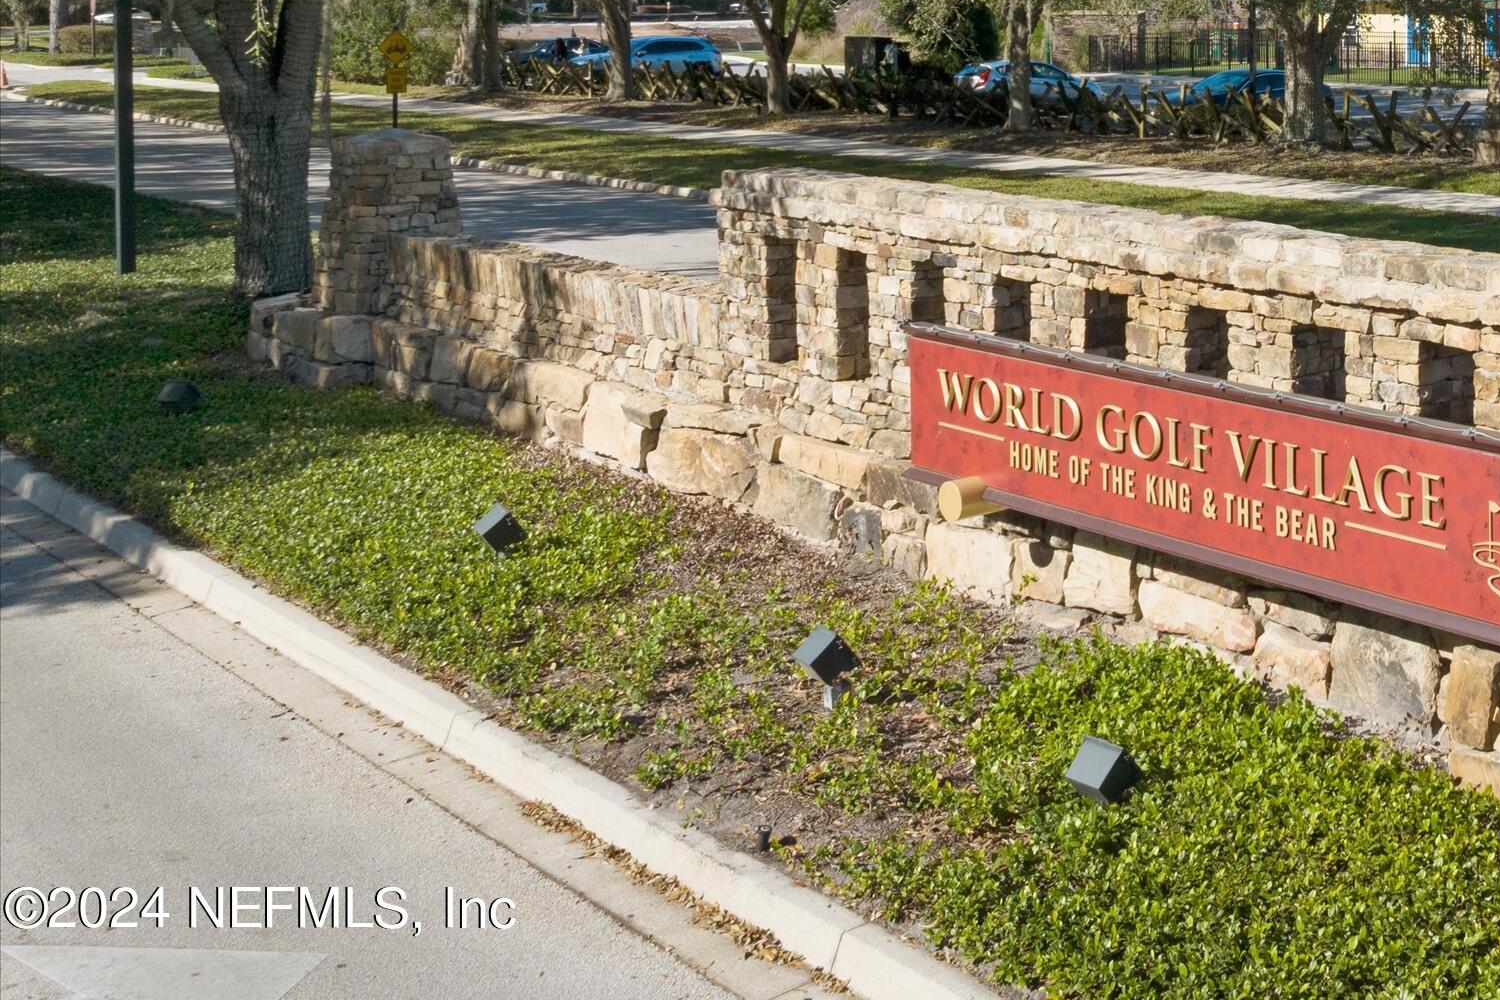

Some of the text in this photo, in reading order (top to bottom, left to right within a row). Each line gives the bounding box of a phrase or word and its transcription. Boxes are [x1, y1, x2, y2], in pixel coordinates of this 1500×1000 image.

[937, 368, 1447, 530] WORLD GOLF VILLAGE
[1009, 440, 1337, 551] HOME OF THE KING & THE BEAR
